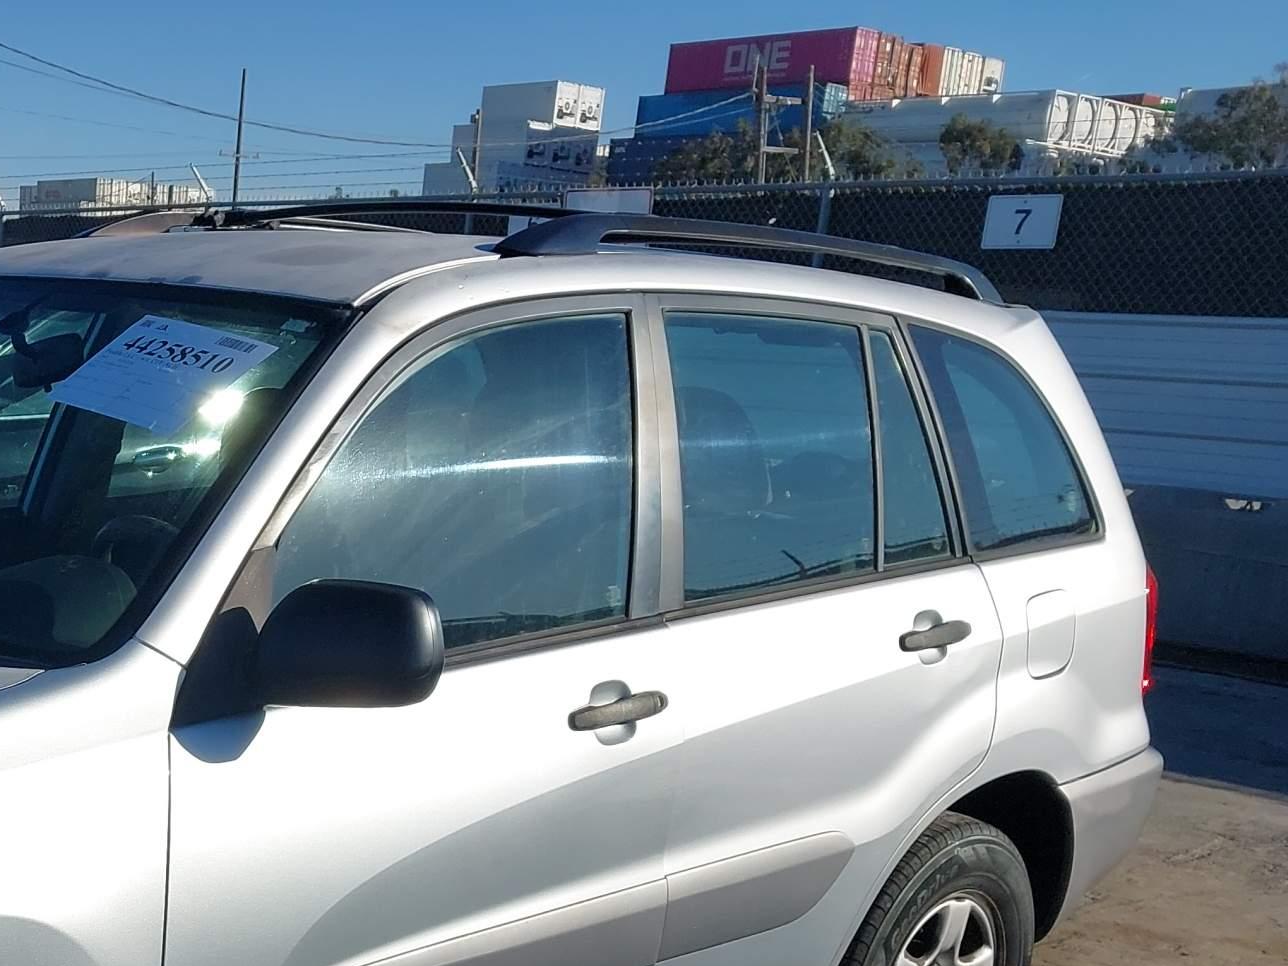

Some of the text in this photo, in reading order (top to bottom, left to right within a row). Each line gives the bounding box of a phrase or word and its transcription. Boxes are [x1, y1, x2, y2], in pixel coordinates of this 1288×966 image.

[724, 41, 792, 73] ONE
[1015, 209, 1032, 235] 7
[124, 335, 234, 373] 44258510
